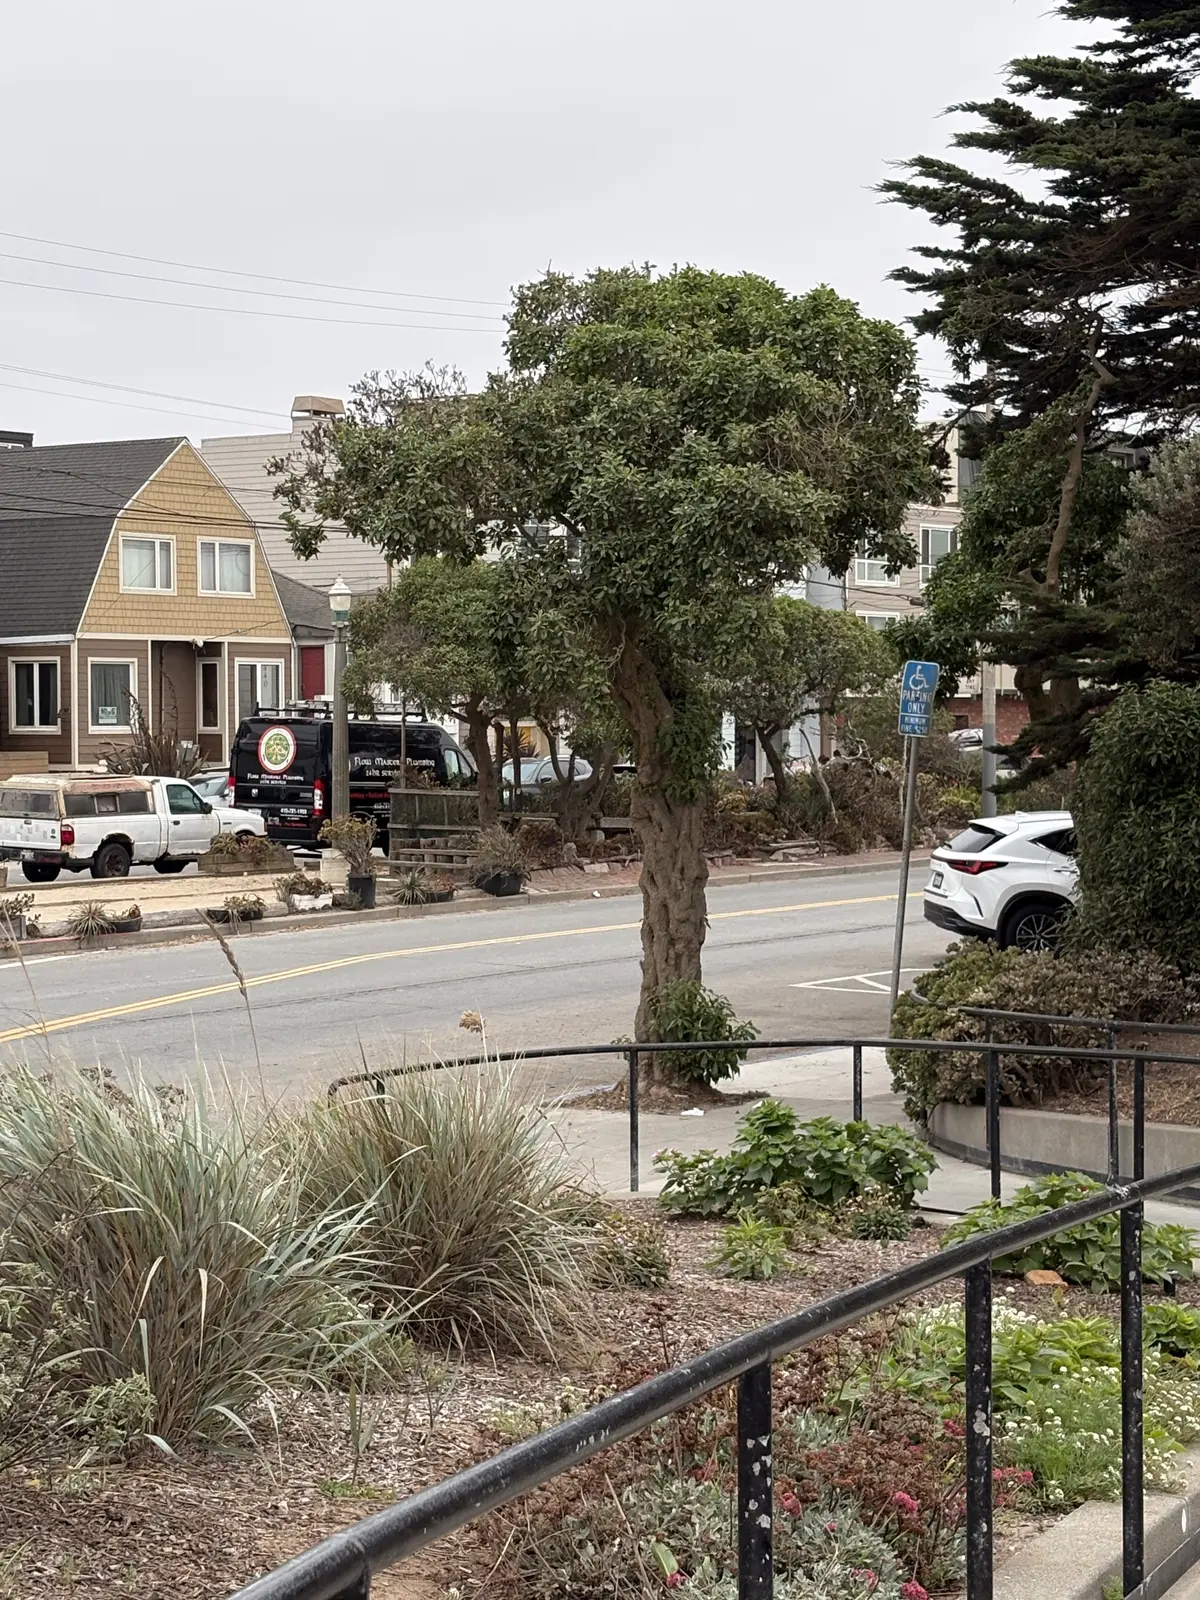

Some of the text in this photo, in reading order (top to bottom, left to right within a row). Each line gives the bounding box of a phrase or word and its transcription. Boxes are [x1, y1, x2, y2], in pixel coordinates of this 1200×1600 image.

[903, 690, 932, 702] PARKING
[907, 702, 925, 714] ONLY
[354, 757, 372, 766] Flow
